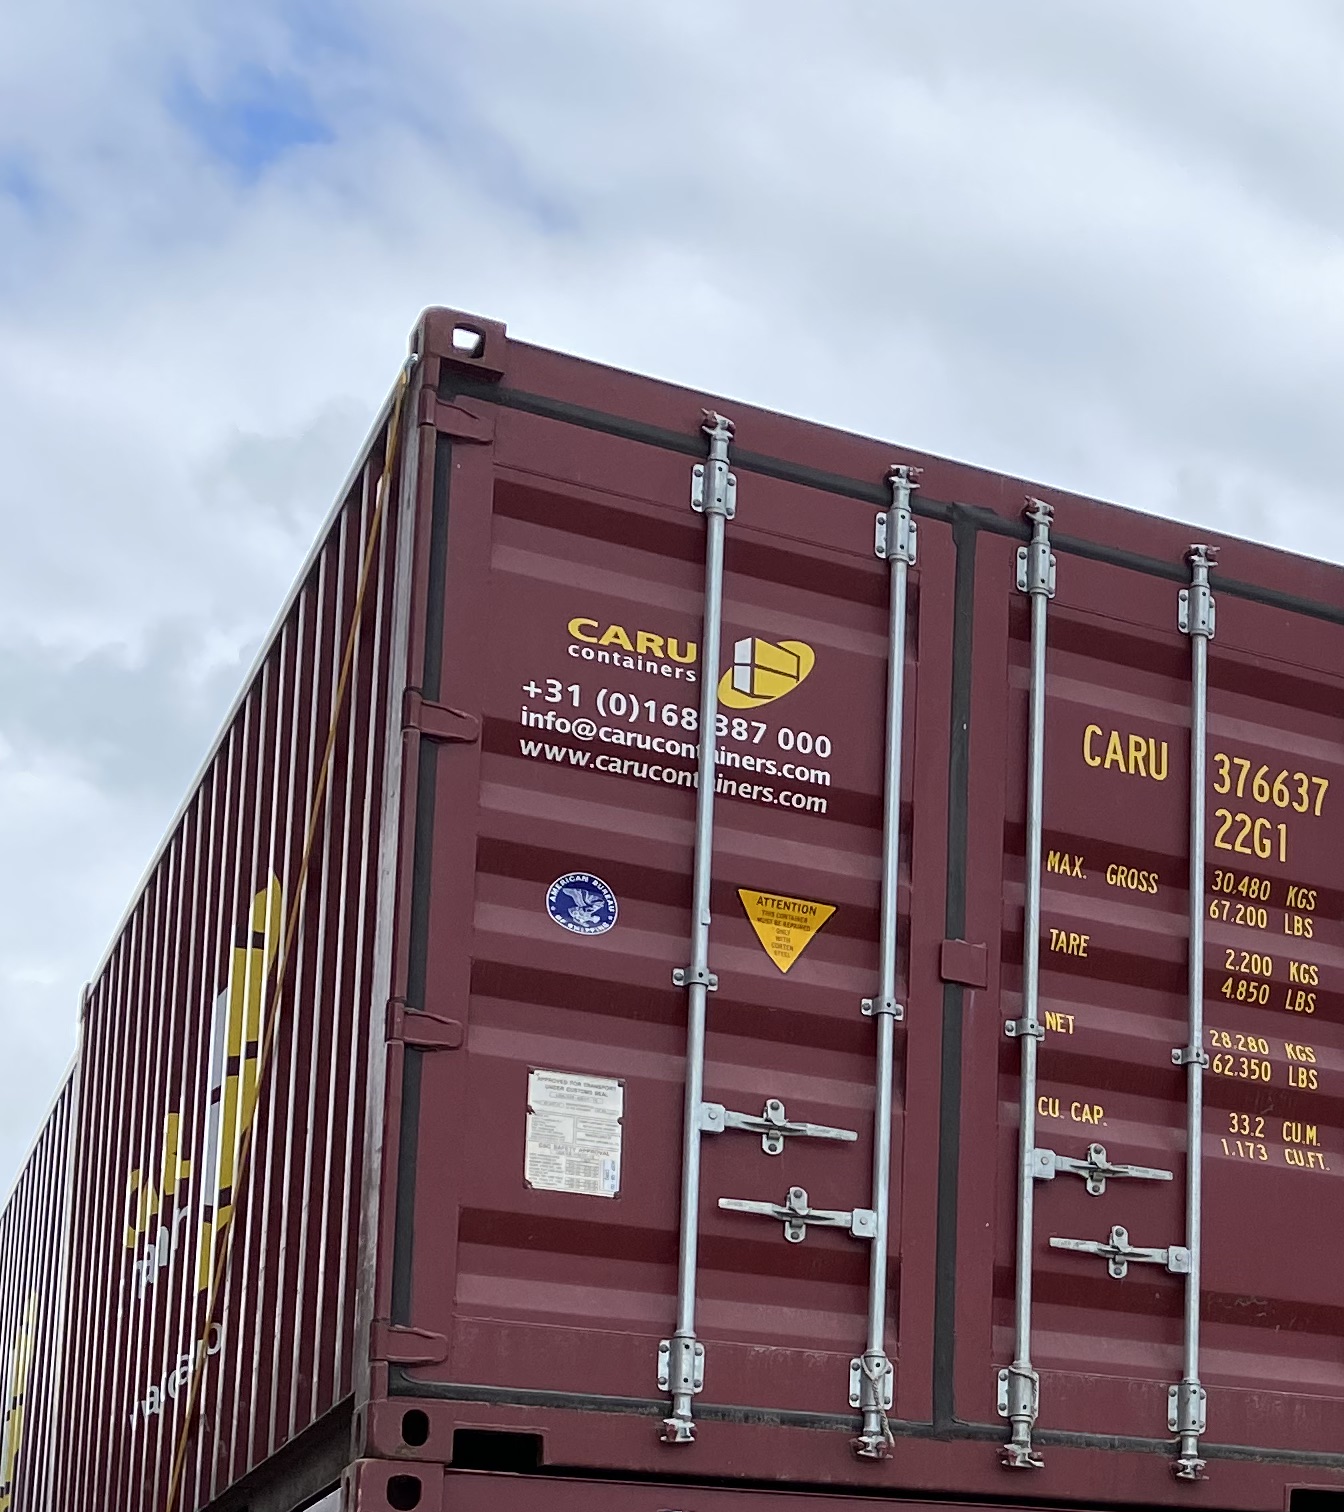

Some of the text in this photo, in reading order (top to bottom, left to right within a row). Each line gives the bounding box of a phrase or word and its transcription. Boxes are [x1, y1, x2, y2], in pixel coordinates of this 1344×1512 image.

[567, 617, 698, 664] CARU
[568, 644, 697, 682] containers
[522, 678, 581, 707] +31
[596, 688, 698, 731] (0)168
[777, 727, 832, 758] 000
[1083, 724, 1170, 781] CARU
[1212, 753, 1330, 817] 376637
[1213, 809, 1289, 863] 22G1
[1047, 850, 1159, 894] MAX. GROSS
[549, 875, 615, 912] AMERICAN BUREAU
[756, 895, 818, 916] ATTENTION
[1286, 885, 1318, 911] KGS
[1284, 912, 1314, 938] LBS
[1050, 928, 1090, 958] TARE
[1289, 960, 1319, 986] KGS
[1285, 988, 1317, 1014] LBS
[1044, 1010, 1075, 1035] NET
[1284, 1042, 1317, 1063] KGS
[1288, 1065, 1318, 1090] LBS
[1070, 1101, 1108, 1127] CAP.
[1229, 1112, 1265, 1138] 33.2
